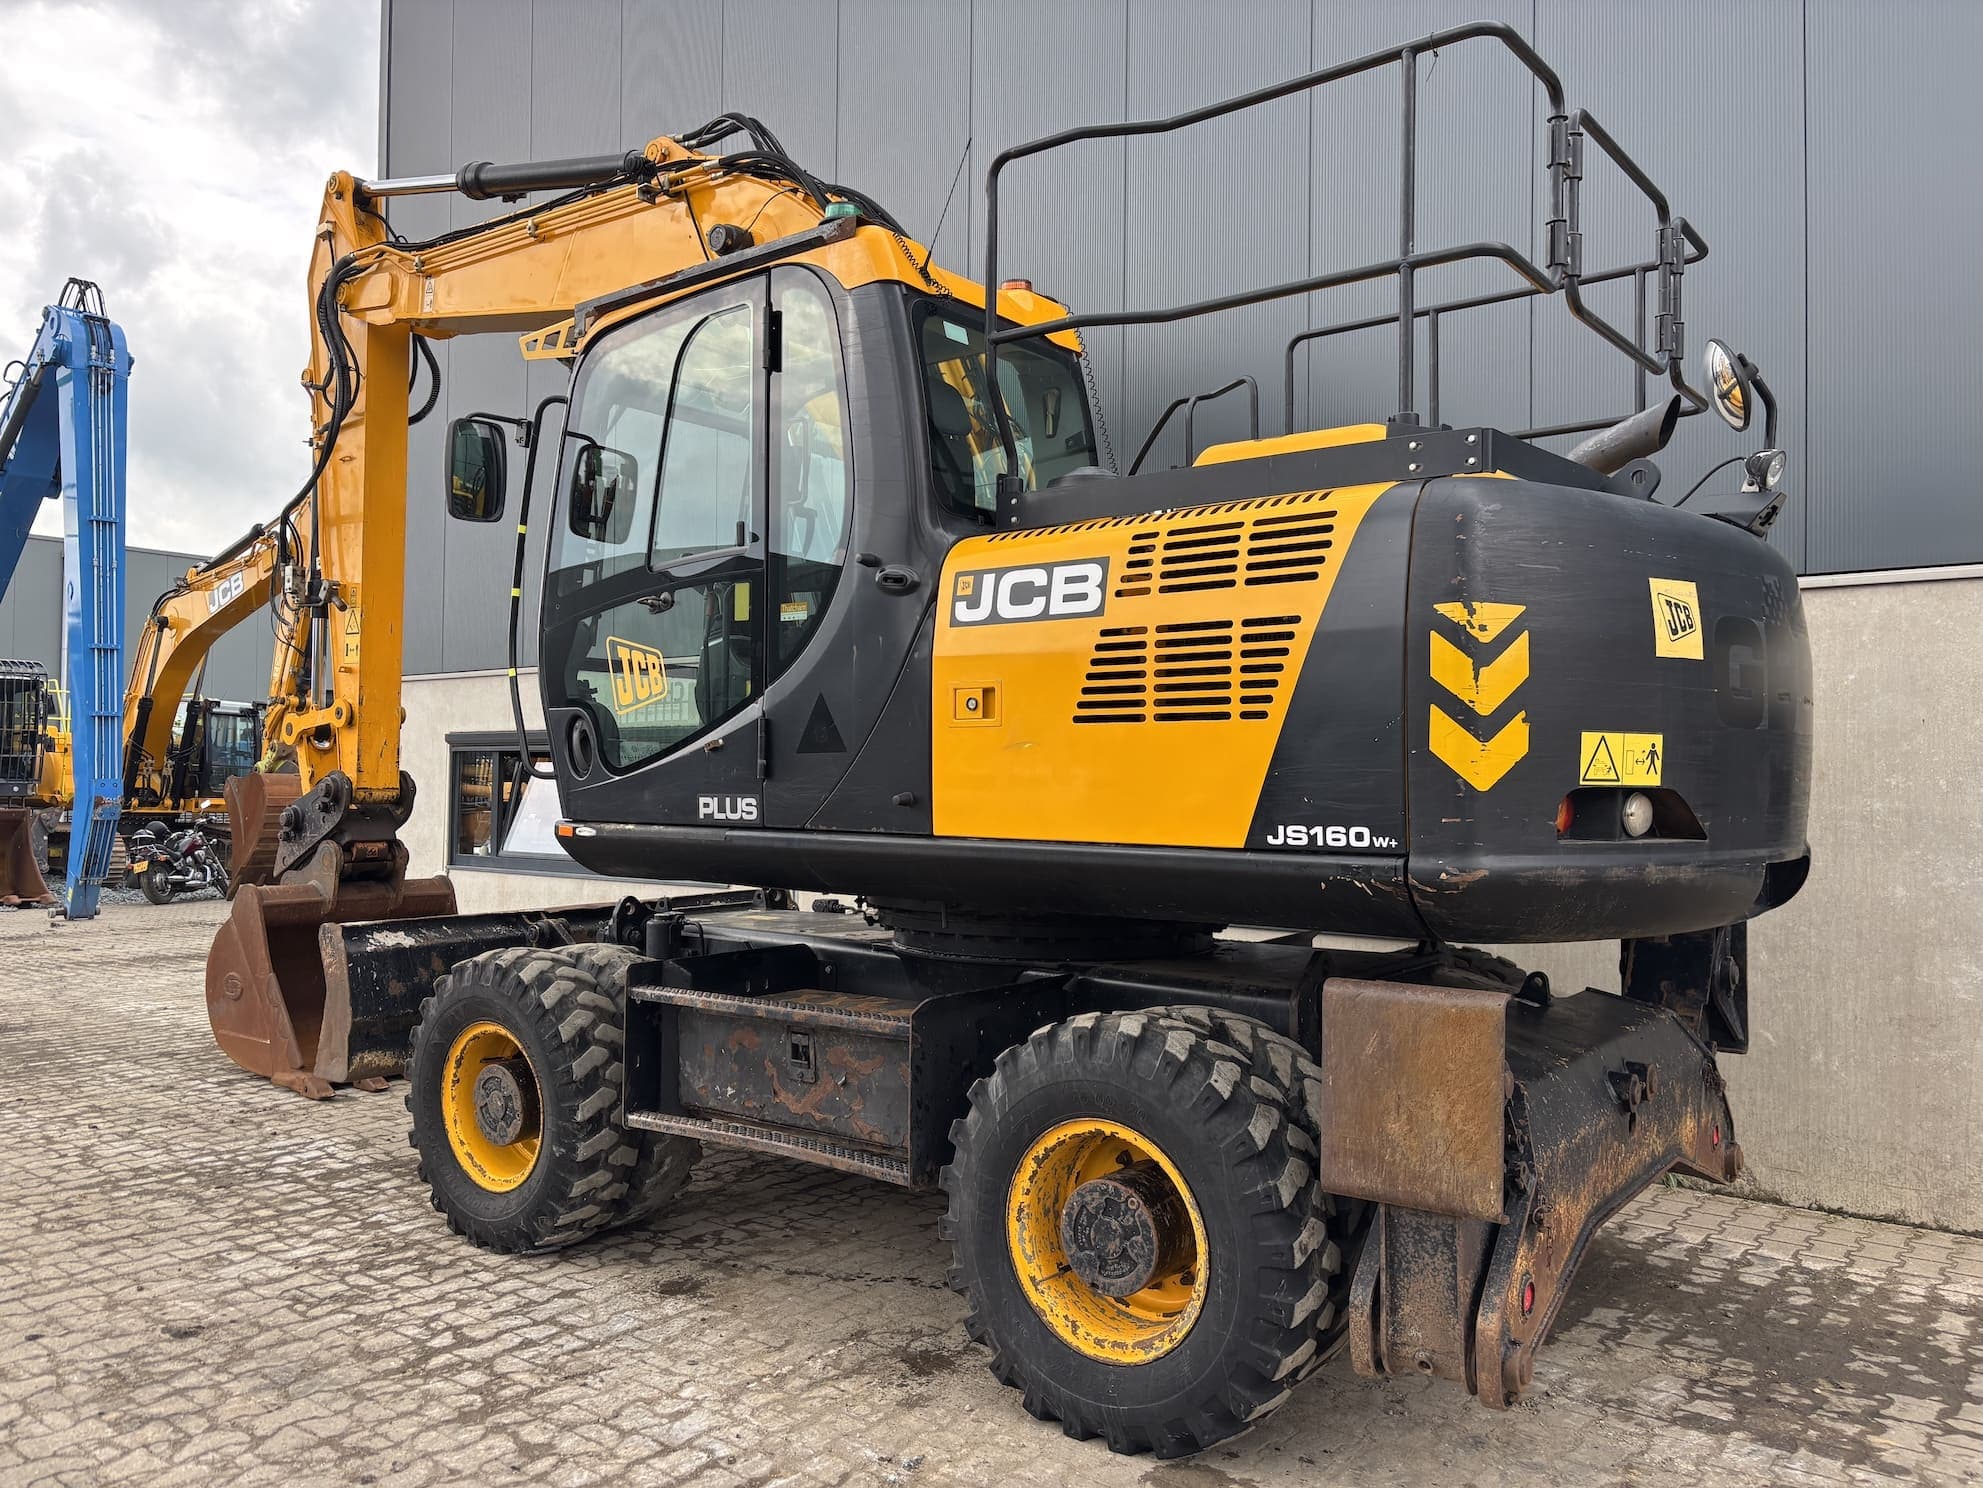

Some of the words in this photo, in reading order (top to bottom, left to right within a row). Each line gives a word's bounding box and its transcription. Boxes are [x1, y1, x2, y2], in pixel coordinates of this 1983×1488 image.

[209, 571, 244, 613] JCB
[955, 563, 1103, 622] JCB
[1665, 599, 1694, 636] JCB
[616, 645, 663, 706] JCB
[699, 796, 758, 821] PLUS
